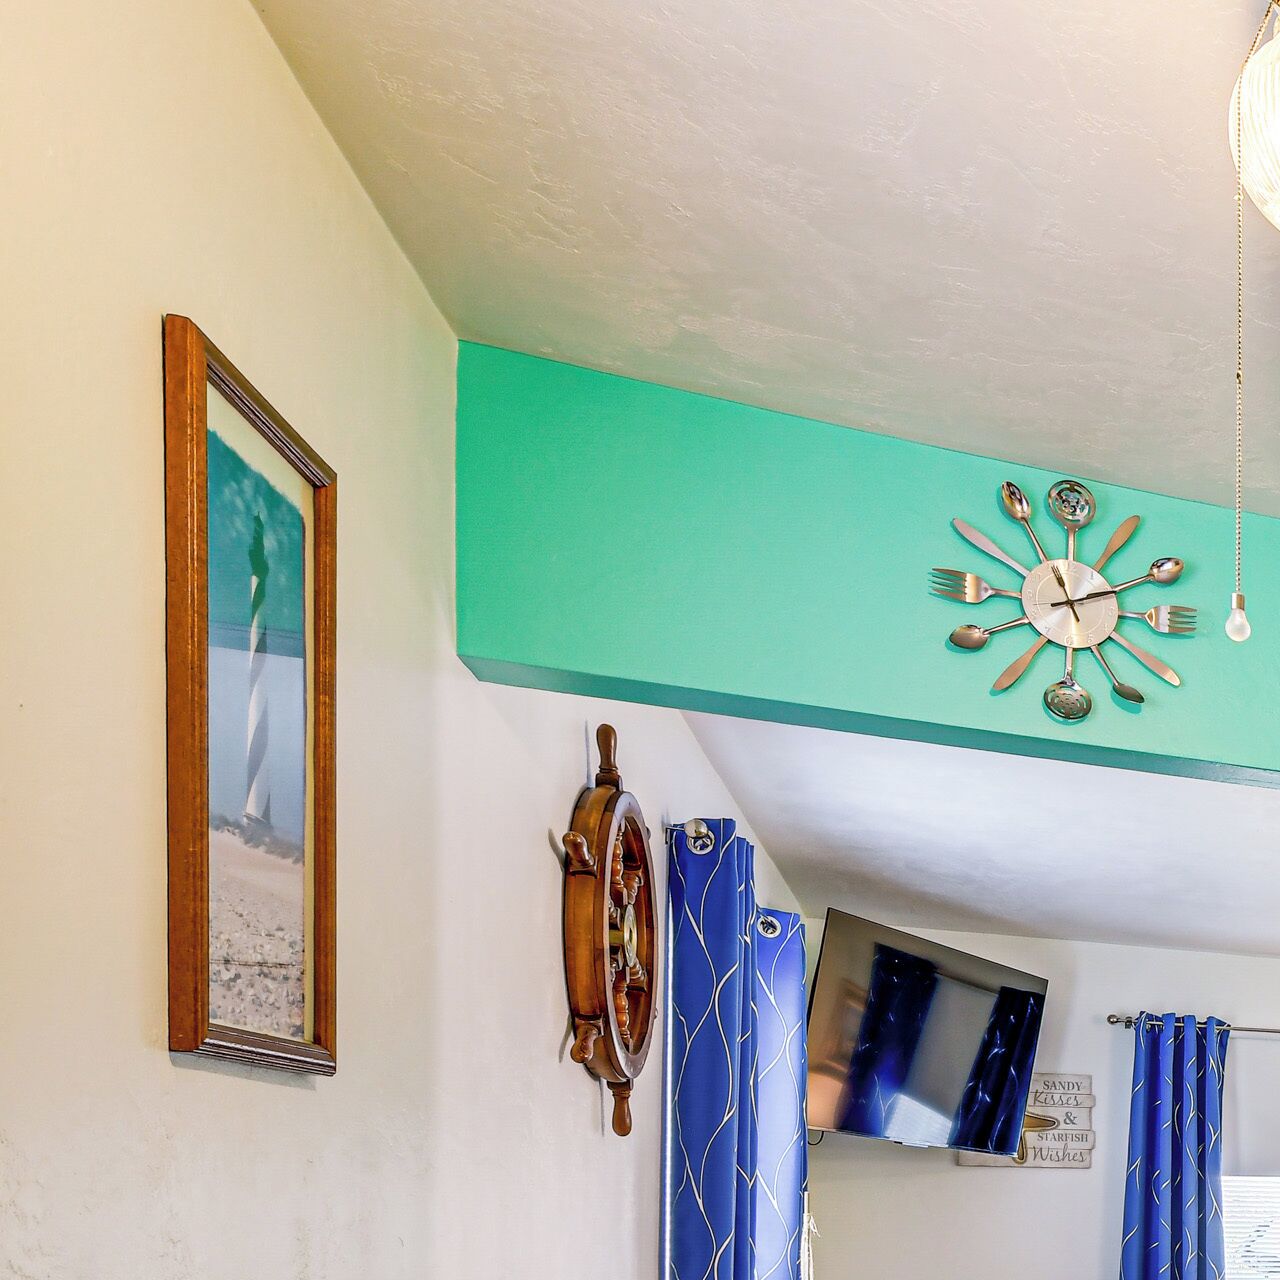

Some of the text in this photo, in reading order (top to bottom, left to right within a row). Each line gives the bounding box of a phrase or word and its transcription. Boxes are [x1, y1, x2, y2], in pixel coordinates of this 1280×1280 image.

[1042, 1080, 1083, 1091] SANDY
[1033, 1089, 1083, 1107] Kisses
[1063, 1111, 1078, 1125] &
[1036, 1132, 1088, 1142] STARFISH
[1032, 1143, 1087, 1163] Wishes
